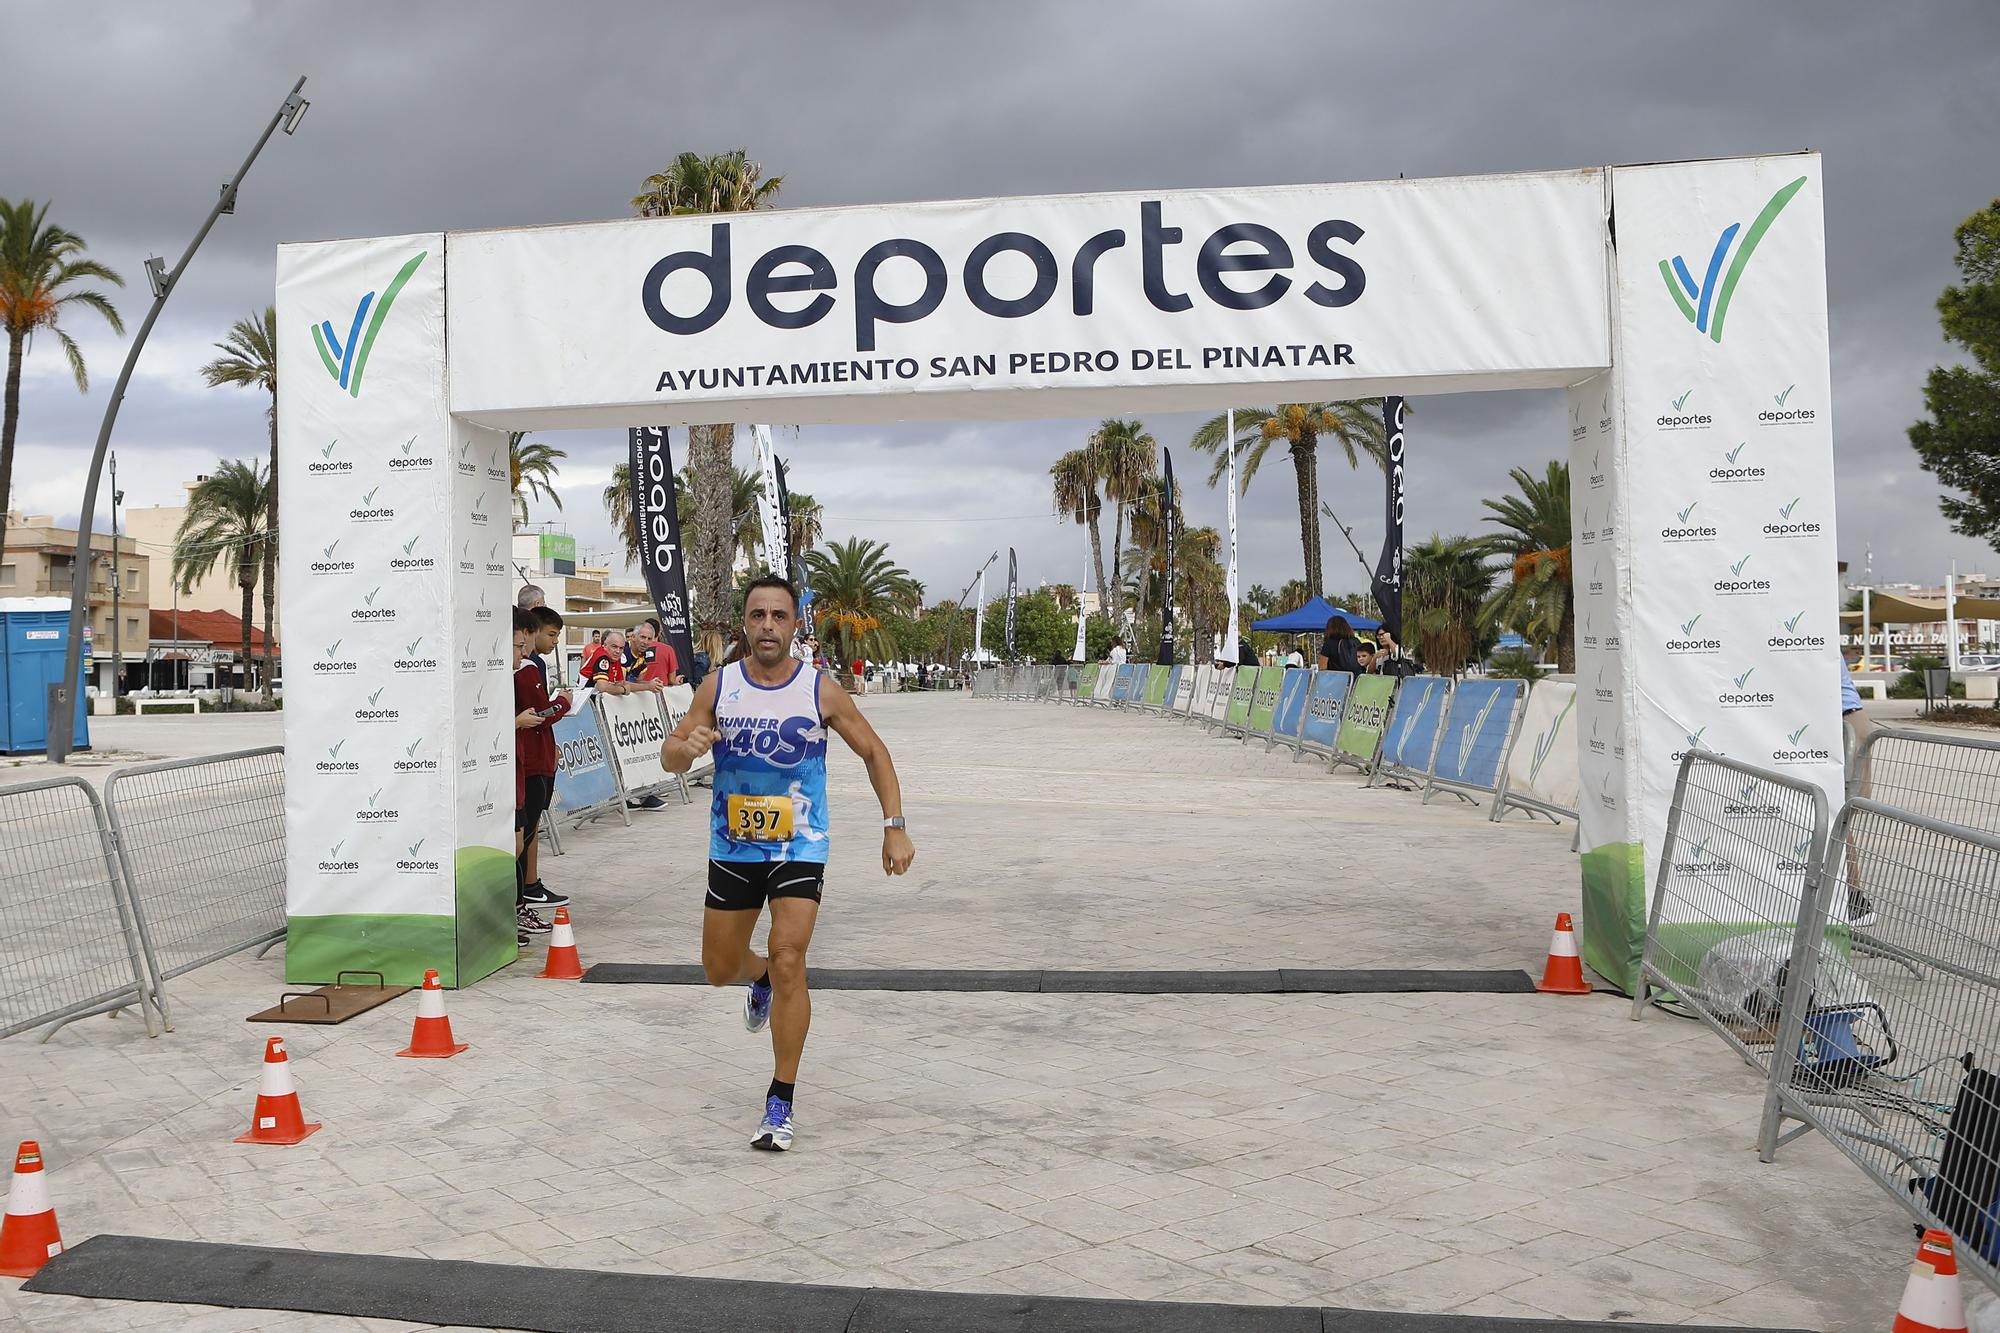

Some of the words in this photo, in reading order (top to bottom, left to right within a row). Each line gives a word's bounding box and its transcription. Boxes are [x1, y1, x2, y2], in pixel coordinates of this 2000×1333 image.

[642, 200, 1367, 352] deportes
[655, 358, 919, 392] AYUNTAMIENTO
[928, 354, 997, 377] SAN
[1008, 350, 1120, 375] PEDRO
[1131, 347, 1193, 370] DEL
[1202, 343, 1356, 369] PINATAR
[1657, 414, 1712, 427] deportes
[1758, 408, 1815, 422] deportes
[309, 461, 353, 471] deportes
[389, 457, 432, 468] deportes
[1709, 466, 1765, 480] deportes
[350, 508, 394, 518] deportes
[1662, 526, 1717, 539] deportes
[1763, 521, 1820, 535] deportes
[311, 561, 354, 572] deportes
[390, 557, 434, 569] deportes
[1714, 578, 1770, 592] deportes
[351, 608, 396, 619] deportes
[1666, 638, 1721, 651] deportes
[1768, 635, 1825, 648] deportes
[313, 661, 357, 671] deportes
[394, 658, 436, 670] deportes
[355, 709, 399, 719] deportes
[718, 716, 779, 730] RUNNER
[614, 712, 664, 753] deportes
[556, 729, 603, 777] eportes
[316, 761, 359, 771] deportes
[394, 760, 437, 770] deportes
[356, 809, 399, 819] deportes
[739, 808, 781, 831] 397
[318, 861, 359, 871] deportes
[396, 860, 439, 870] deportes
[1676, 861, 1730, 872] deportes
[1777, 859, 1808, 871] deportes
